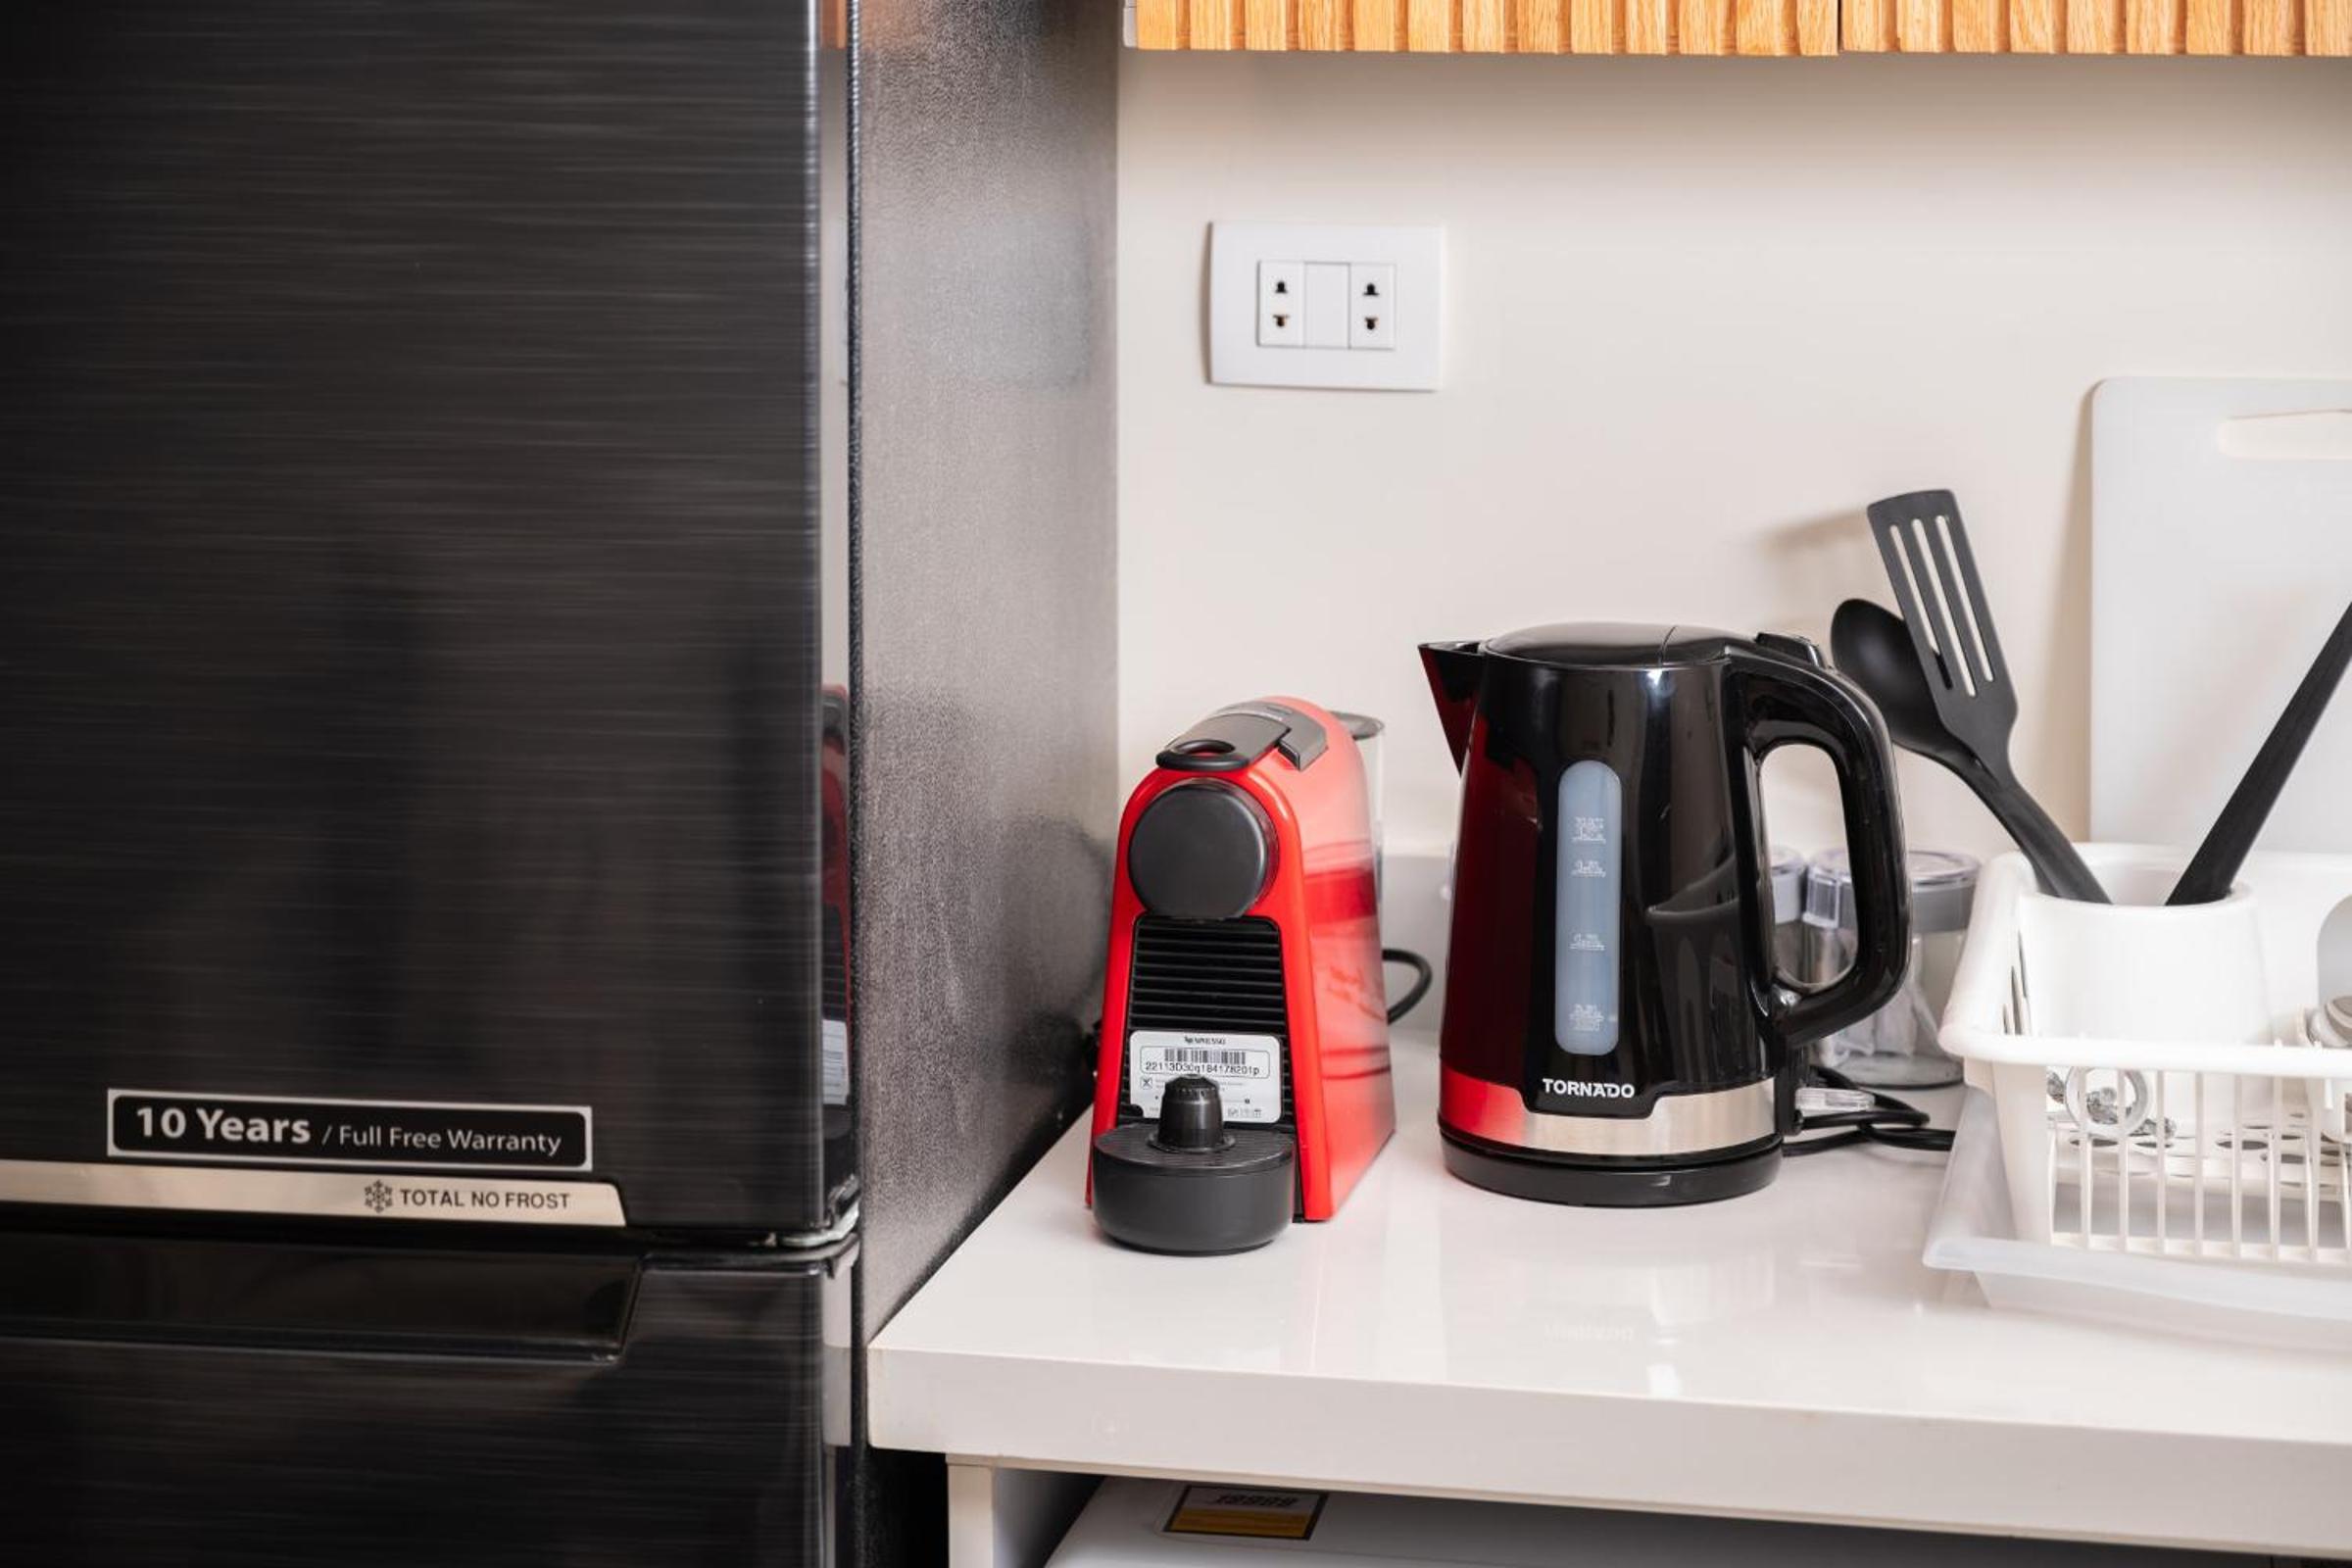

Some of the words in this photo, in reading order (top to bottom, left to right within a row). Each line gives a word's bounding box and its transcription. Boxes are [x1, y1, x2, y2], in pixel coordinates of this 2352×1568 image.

[1542, 1078, 1636, 1099] TORNADO
[137, 1106, 186, 1139] 10
[196, 1107, 311, 1144] Years
[338, 1125, 382, 1147] Full
[389, 1127, 442, 1149] Free
[447, 1129, 562, 1156] Warranty
[400, 1188, 465, 1207] TOTAL
[470, 1191, 500, 1207] NO
[505, 1192, 570, 1208] FROST
